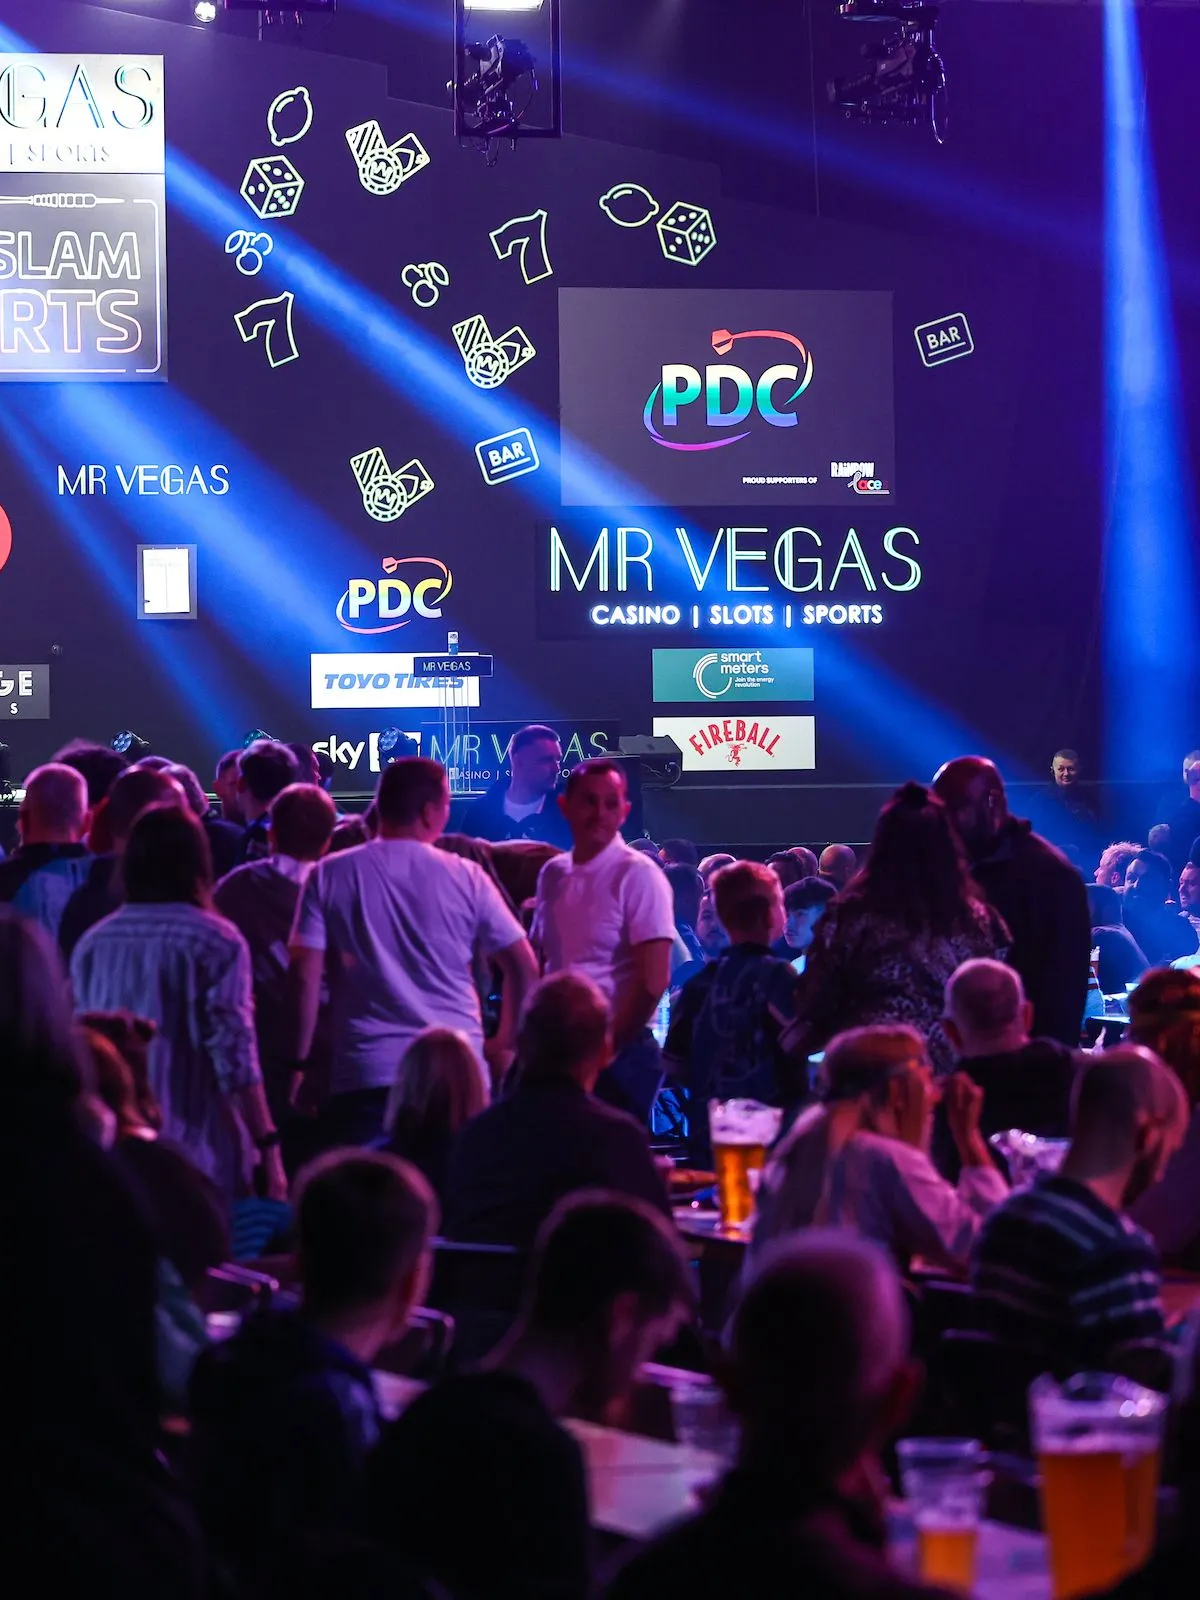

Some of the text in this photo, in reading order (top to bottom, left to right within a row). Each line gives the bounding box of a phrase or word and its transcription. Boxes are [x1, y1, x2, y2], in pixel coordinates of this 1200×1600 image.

[926, 326, 961, 351] BAR
[661, 363, 799, 428] PDC
[488, 442, 525, 468] BAR
[57, 464, 231, 496] MR VEGAS
[550, 527, 922, 592] MR VEGAS
[348, 578, 443, 619] PDC
[591, 604, 883, 626] CASINO SLOTS SPORTS
[423, 661, 471, 671] MR VEGAS
[720, 650, 762, 663] smart
[720, 663, 769, 674] meters
[324, 673, 465, 689] TOYO TIRES
[430, 732, 609, 765] MR VAS
[688, 719, 781, 757] FIREBALL
[450, 769, 491, 779] ASINO
